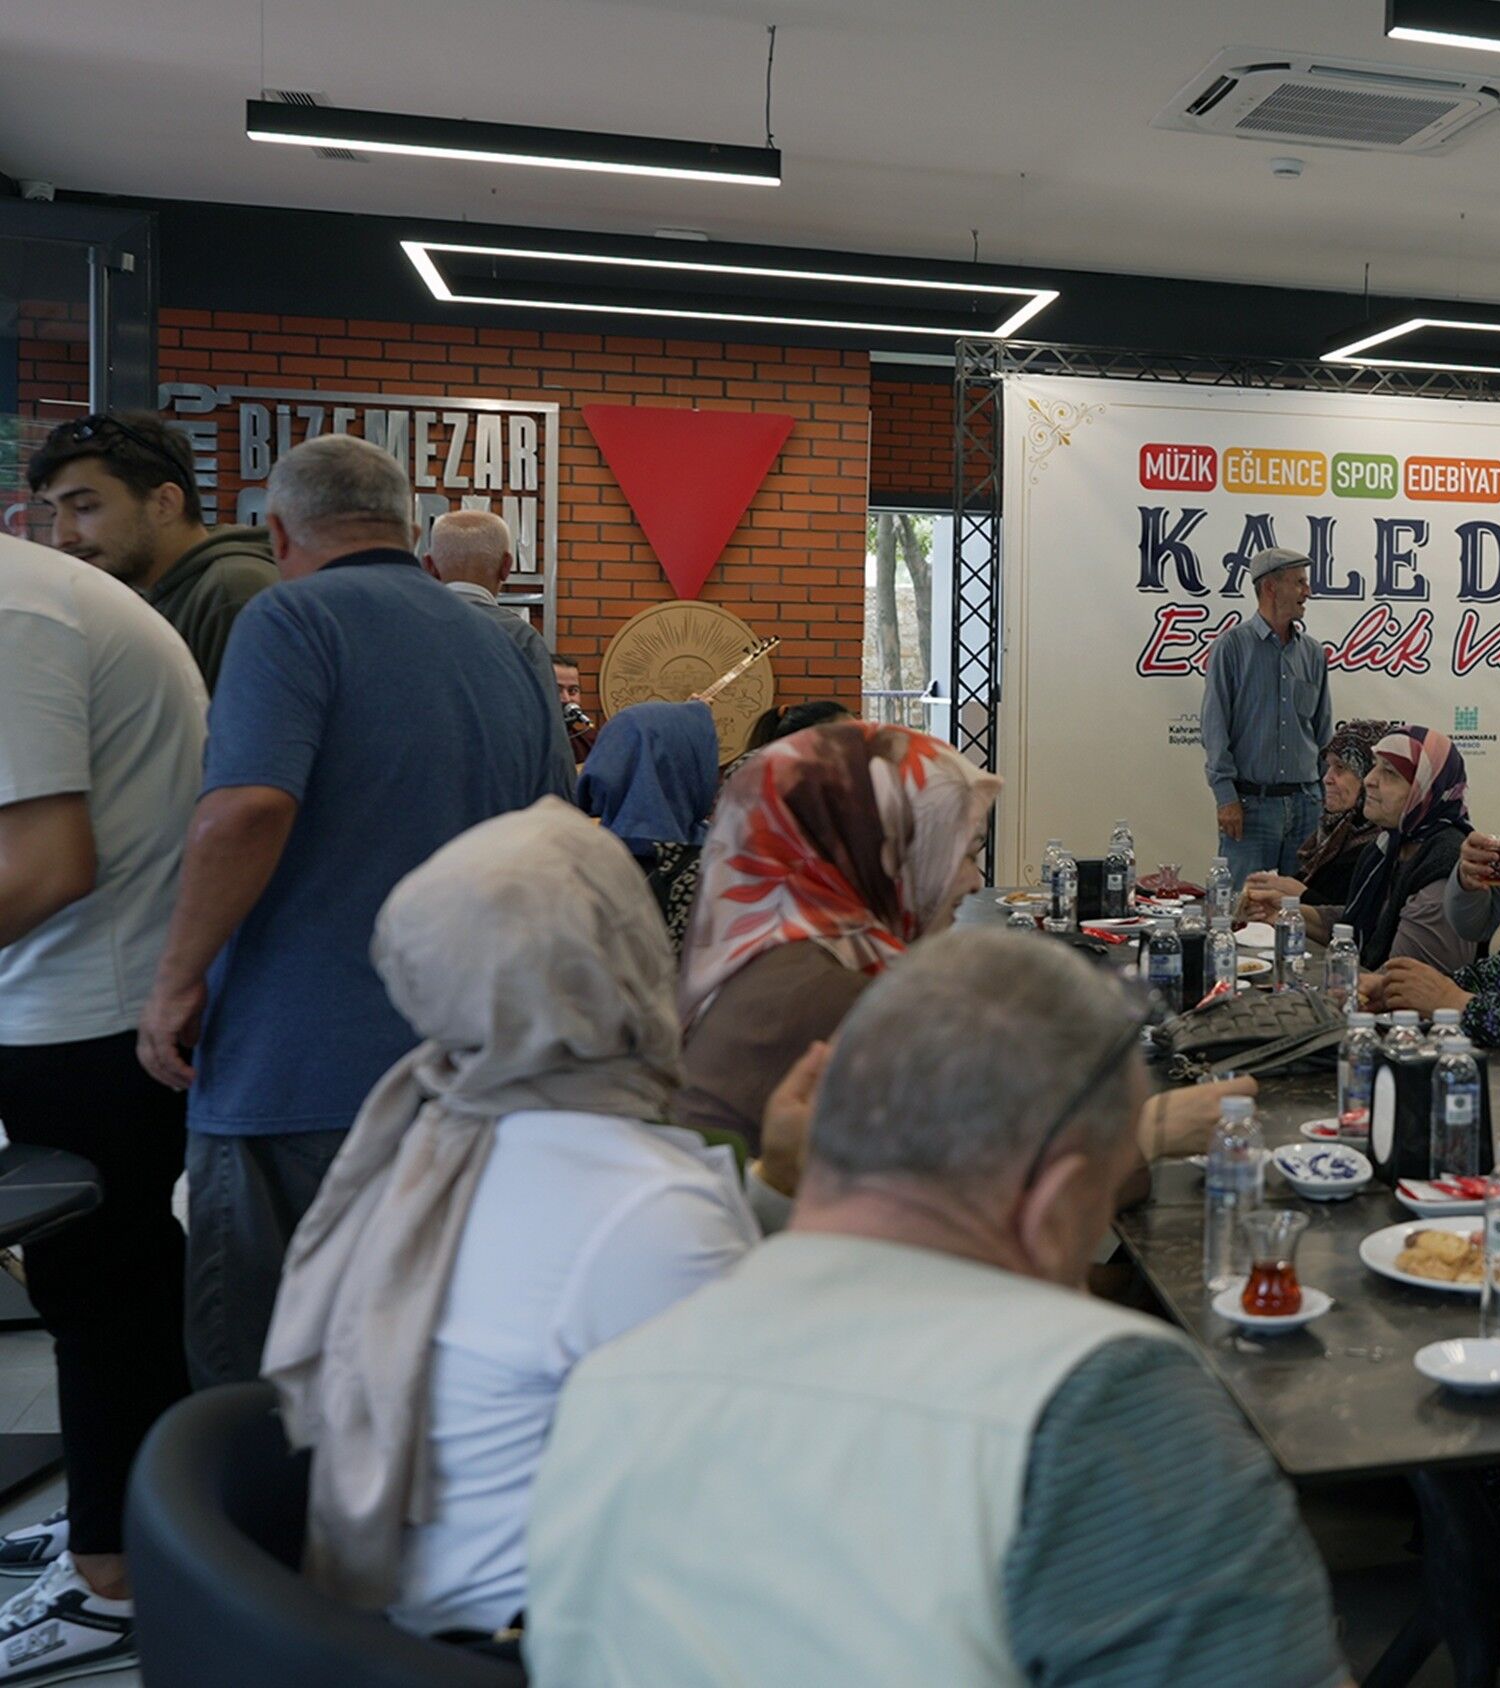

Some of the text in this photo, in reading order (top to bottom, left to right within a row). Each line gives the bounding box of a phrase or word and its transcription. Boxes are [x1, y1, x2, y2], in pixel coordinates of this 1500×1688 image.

[1145, 448, 1213, 483] MÜZİK
[1227, 450, 1323, 488] EĞLENCE
[1336, 461, 1393, 491] SPOR
[1408, 461, 1500, 495] EDEBİYAT
[1136, 506, 1430, 602] KALE
